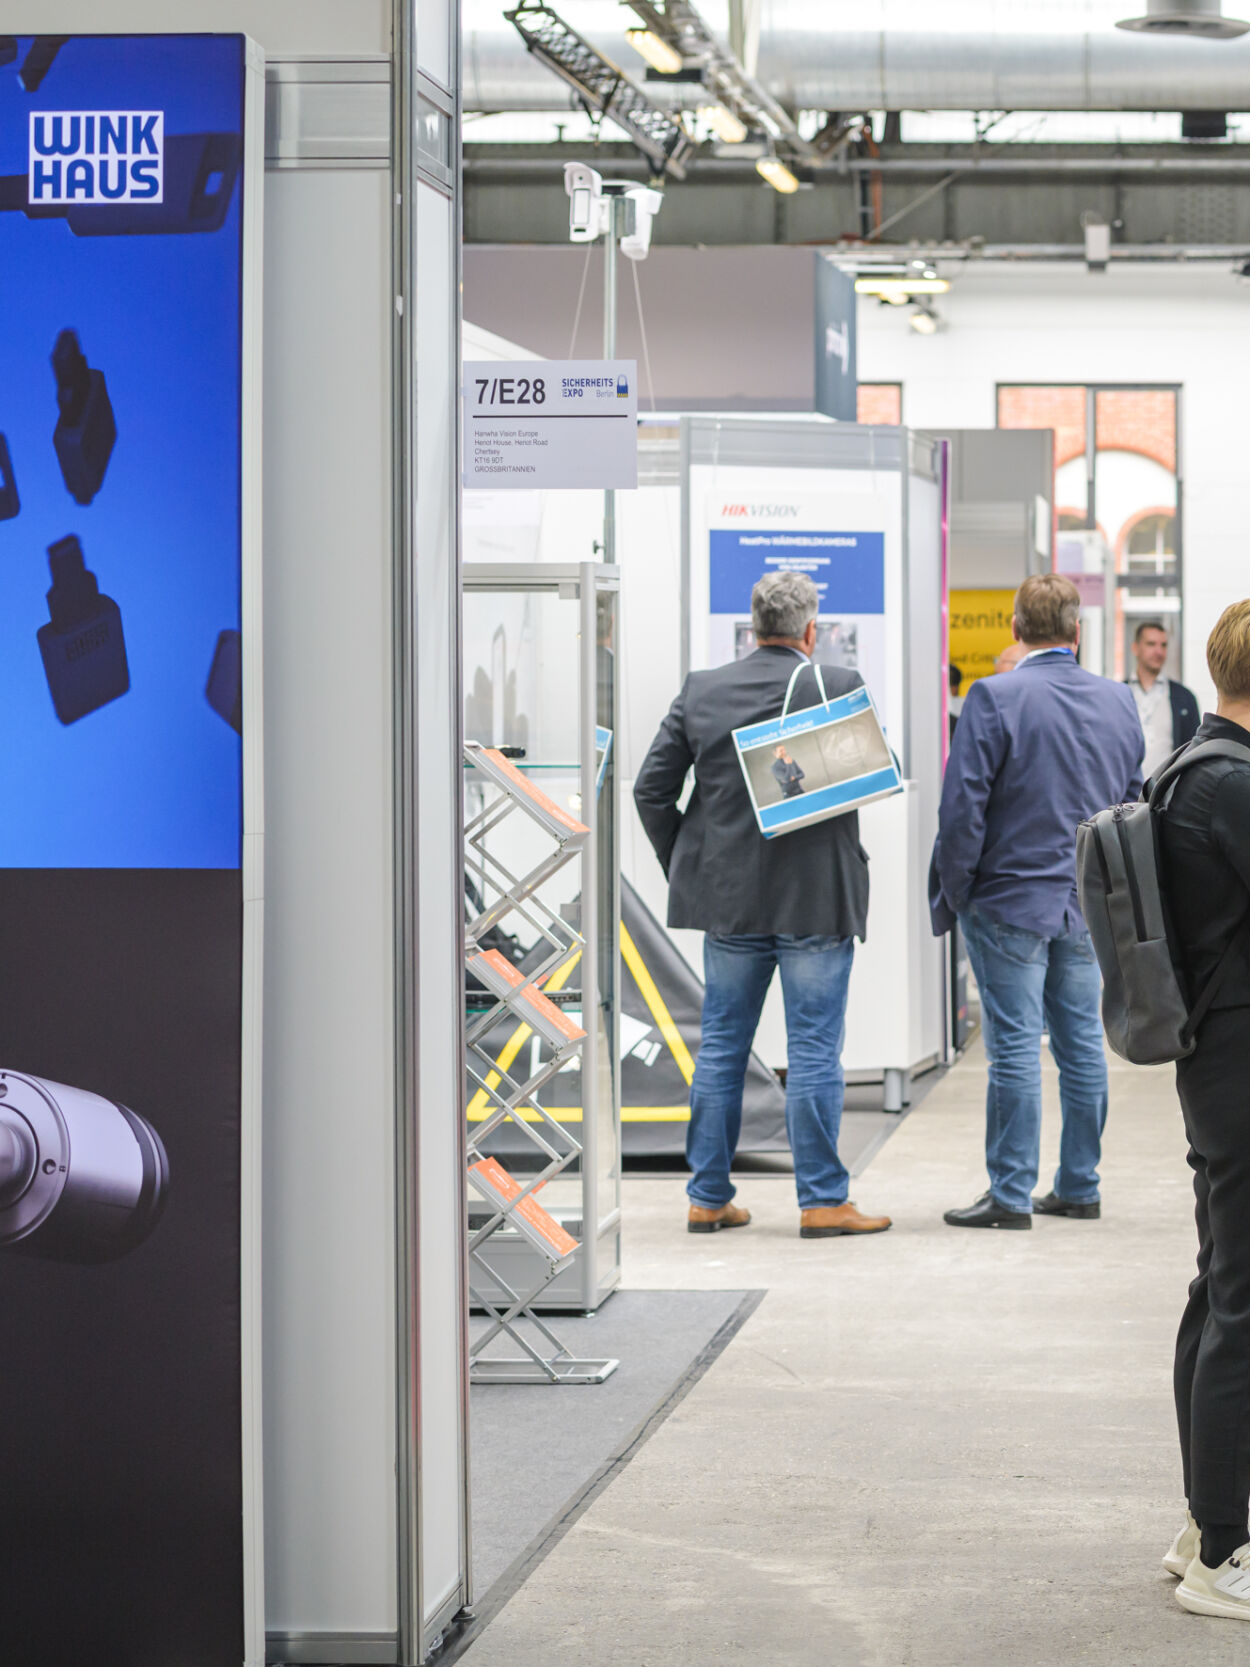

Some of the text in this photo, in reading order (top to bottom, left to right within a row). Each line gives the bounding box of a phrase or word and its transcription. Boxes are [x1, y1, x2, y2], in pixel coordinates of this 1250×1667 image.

[34, 115, 159, 156] WINK
[33, 159, 159, 199] HAUS
[562, 378, 614, 388] SICHERHEITS
[475, 378, 546, 405] 7/E28
[562, 388, 614, 398] EXPO Berlin
[518, 430, 539, 438] Europe
[474, 465, 536, 473] GROSSBRITANNIEN
[722, 504, 799, 517] HIKVISION
